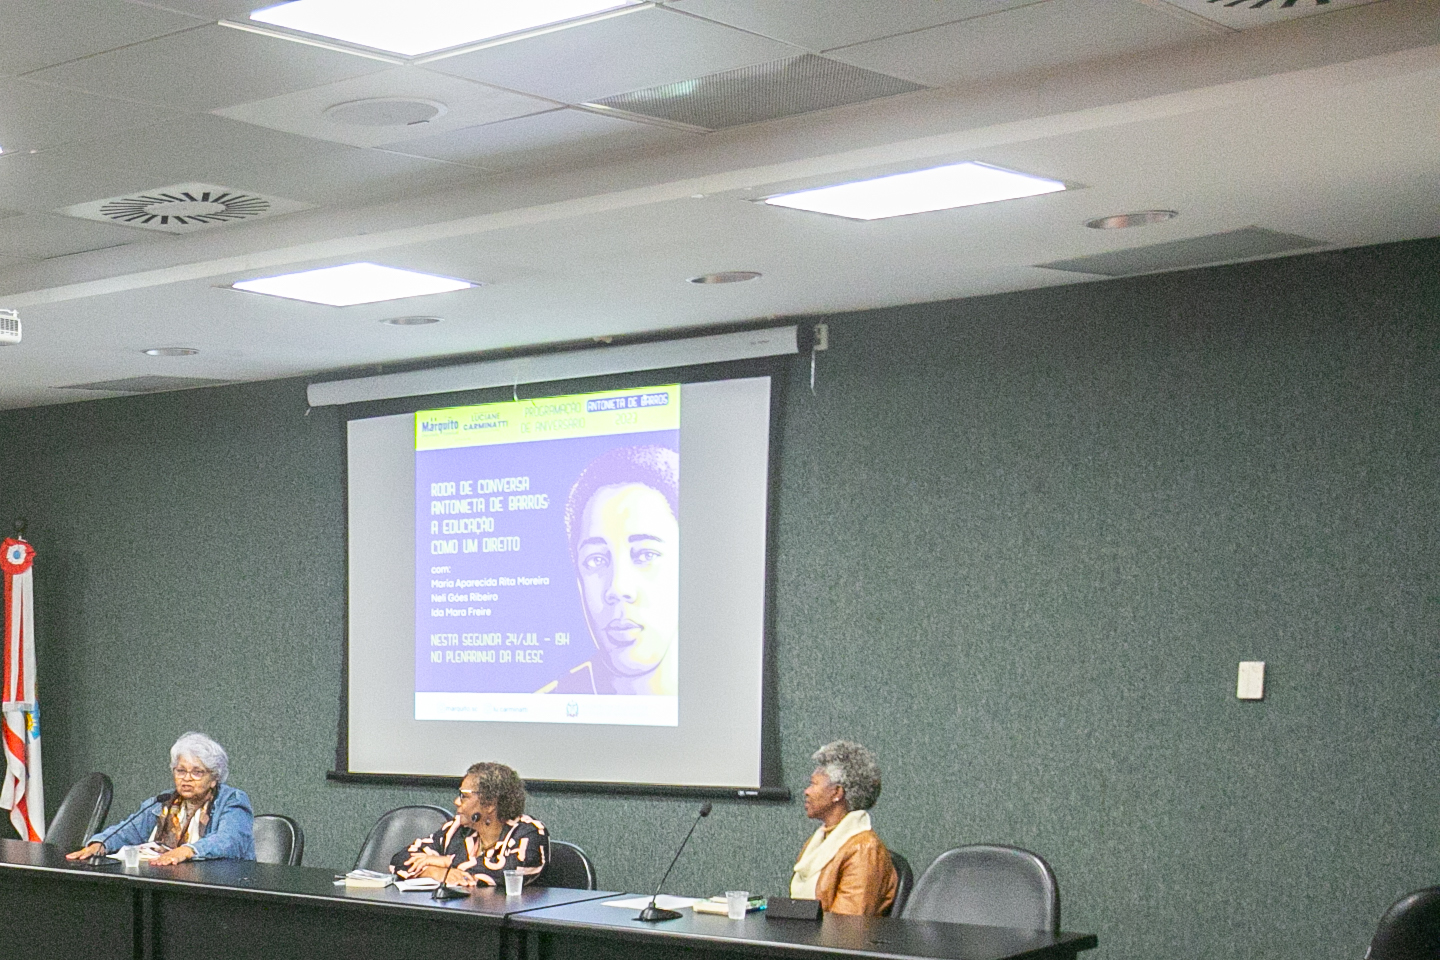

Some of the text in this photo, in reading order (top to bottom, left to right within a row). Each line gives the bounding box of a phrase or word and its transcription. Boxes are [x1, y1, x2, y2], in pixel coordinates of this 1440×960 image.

[627, 396, 638, 408] DE
[471, 412, 500, 422] LUCIANE
[615, 412, 638, 425] 2023
[422, 419, 459, 433] Marquito
[463, 420, 509, 431] CARMINATTI
[520, 421, 531, 434] DE
[431, 477, 529, 497] RODA DE CONVERSA
[431, 498, 485, 515] ANTONIETA
[489, 496, 504, 512] DE
[431, 516, 494, 535] A EDUCAÇÃO
[430, 536, 520, 554] COMO UM DIREITO
[431, 566, 451, 574] com:
[431, 575, 550, 589] Maria Aparecida Rita Moreira
[431, 592, 498, 602] Neli Góes Ribeiro
[430, 606, 492, 617] Ida Mara Freire
[430, 633, 459, 646] NESTA
[462, 632, 502, 646] SEGUNDA
[506, 632, 539, 646] 24/JUL
[430, 649, 544, 663] NO PLENARINHO DA ALESC
